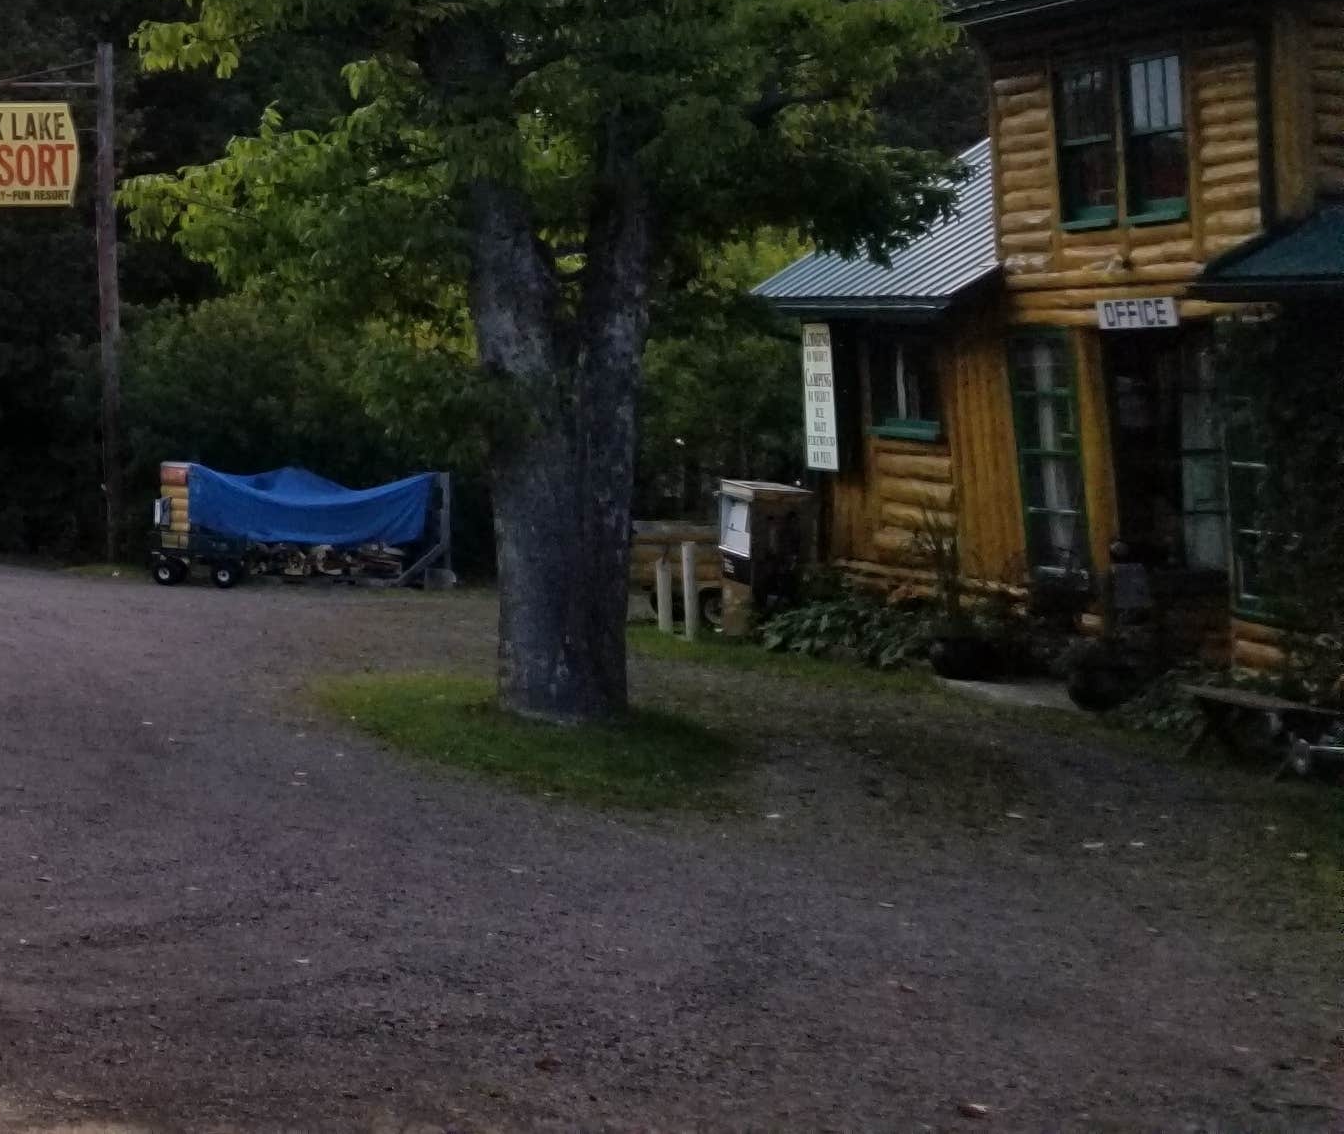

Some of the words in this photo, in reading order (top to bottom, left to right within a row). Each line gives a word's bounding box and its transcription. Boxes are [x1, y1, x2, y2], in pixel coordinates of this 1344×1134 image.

[12, 112, 66, 141] LAKE
[34, 190, 70, 201] RESORT
[1103, 298, 1168, 327] OFFICE
